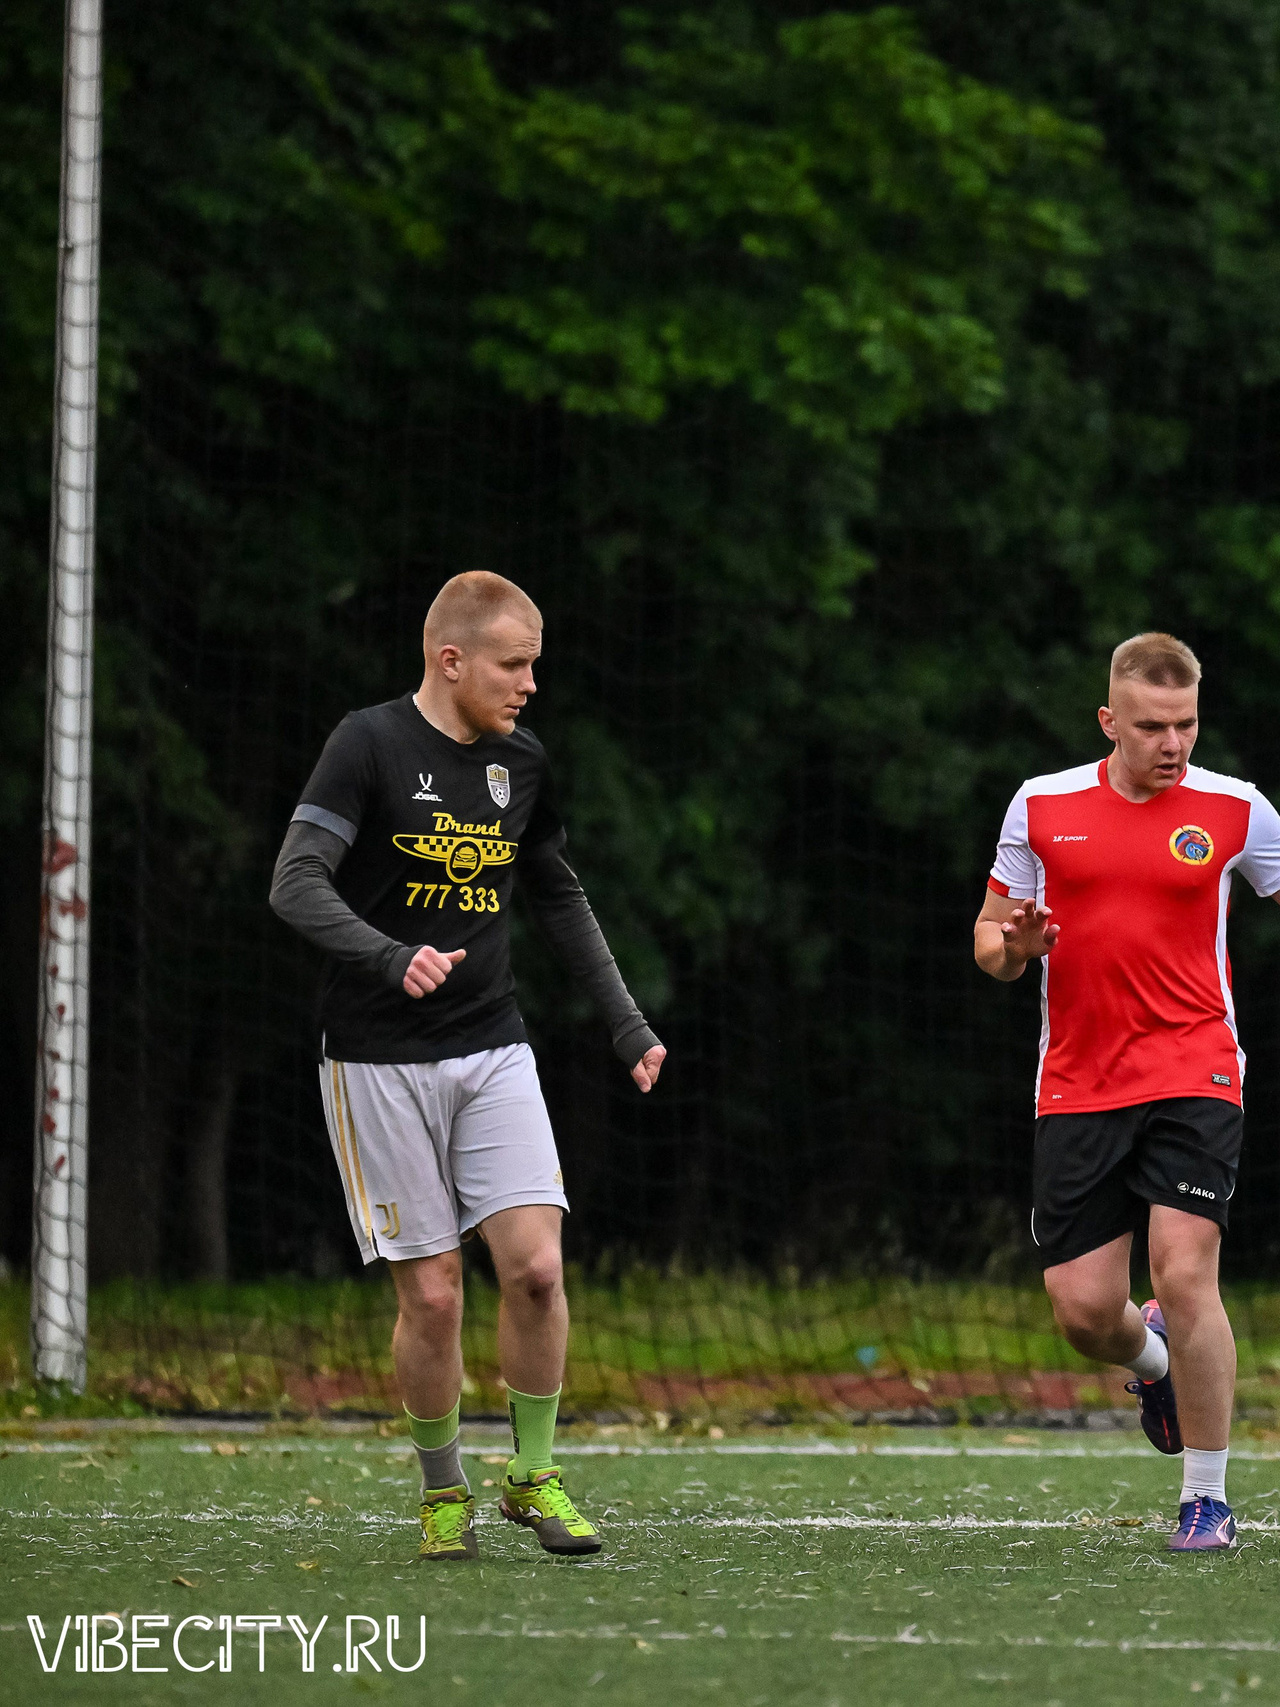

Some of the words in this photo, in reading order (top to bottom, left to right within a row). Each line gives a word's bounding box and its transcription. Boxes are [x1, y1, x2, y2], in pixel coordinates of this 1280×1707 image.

[432, 812, 502, 836] Brand
[406, 882, 452, 909] 777
[459, 886, 500, 912] 333
[1190, 1186, 1215, 1200] JAKO
